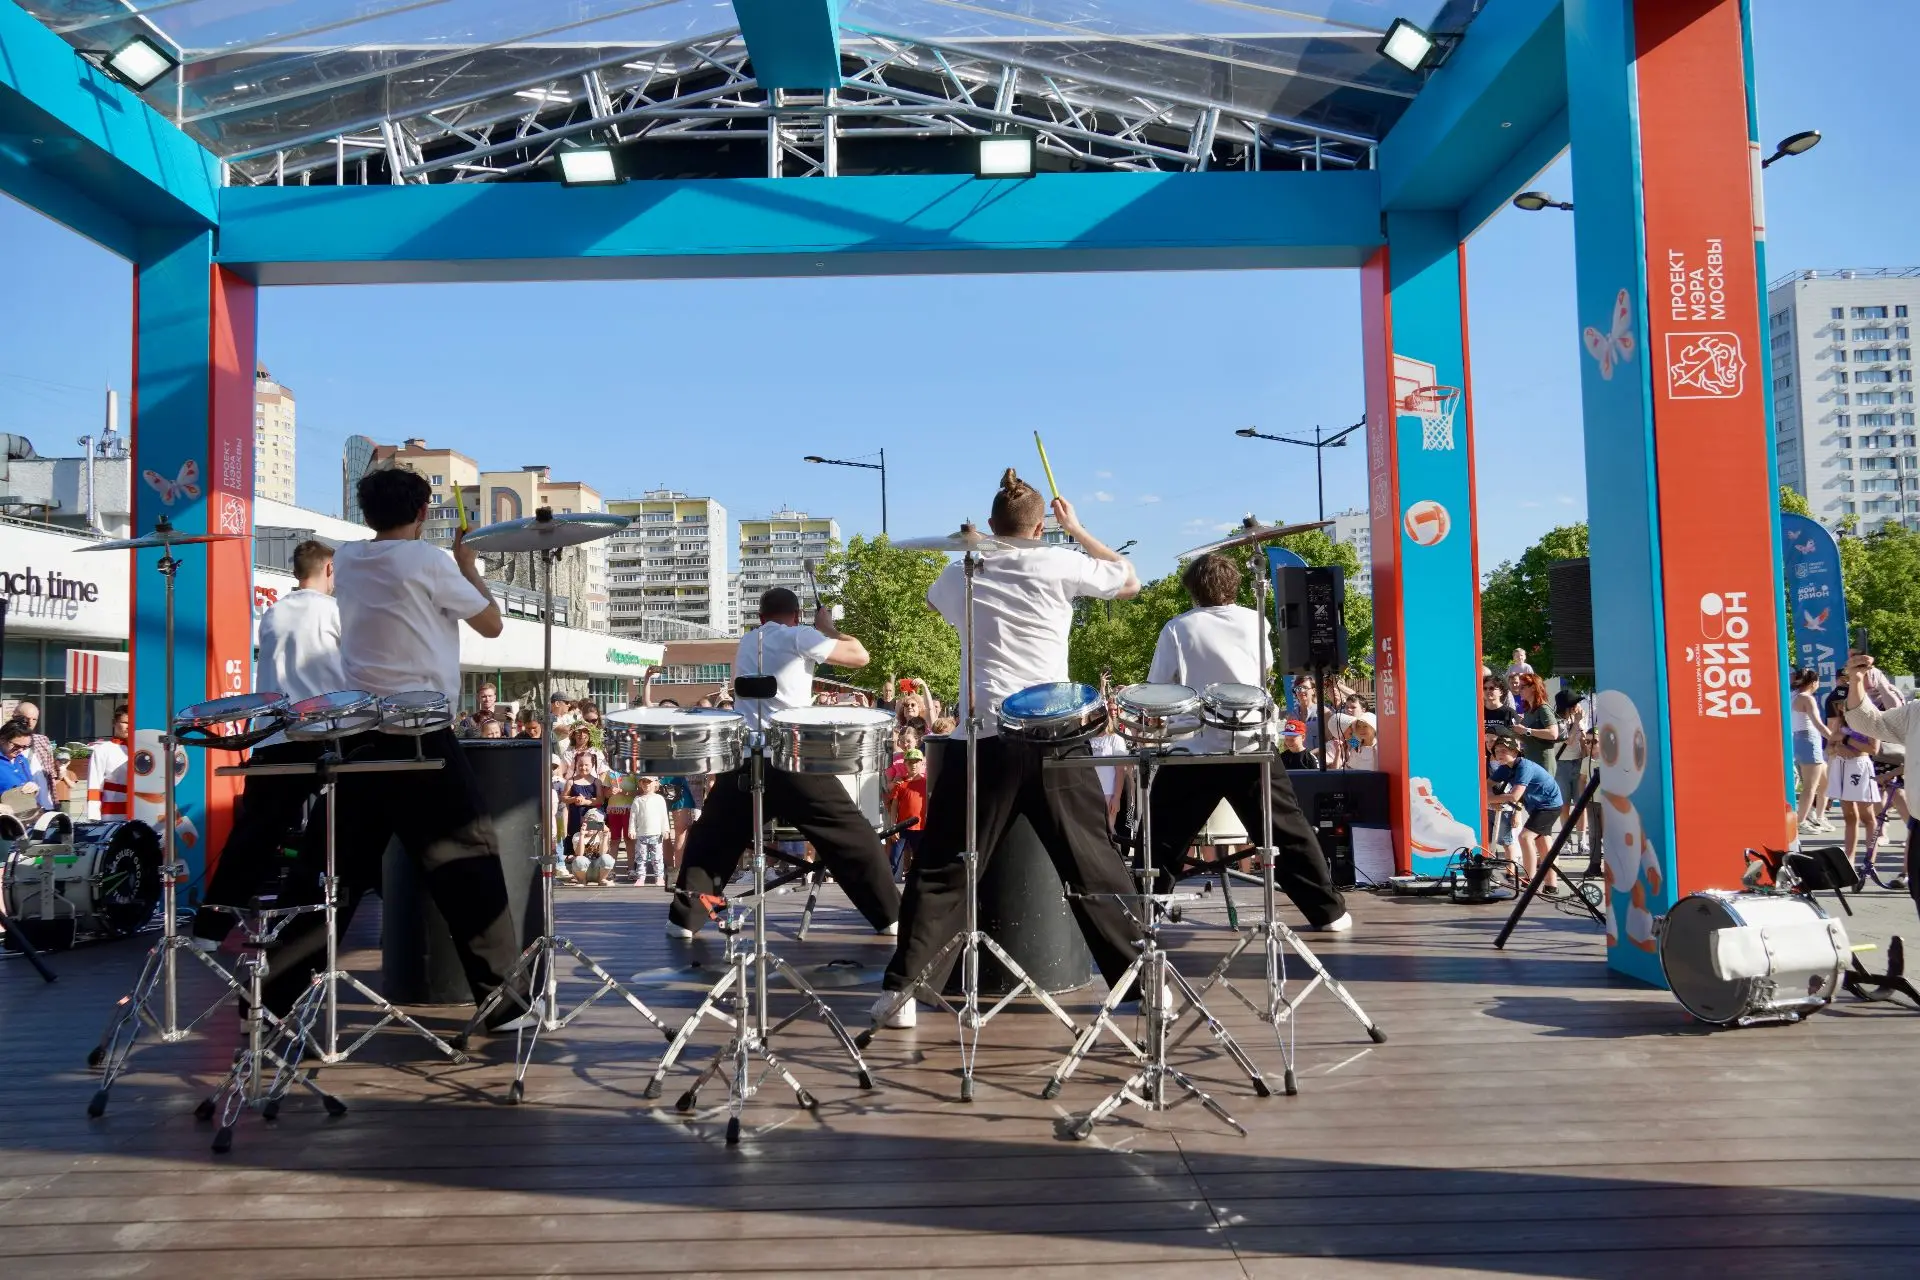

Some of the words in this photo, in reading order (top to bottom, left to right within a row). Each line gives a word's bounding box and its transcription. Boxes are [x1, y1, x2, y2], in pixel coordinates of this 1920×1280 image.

[1669, 249, 1687, 320] ПРОЕКТ
[1689, 268, 1706, 320] МЭРА
[1706, 239, 1726, 320] МОСКВЫ
[47, 570, 98, 602] time
[1816, 643, 1837, 710] ЛЕТ
